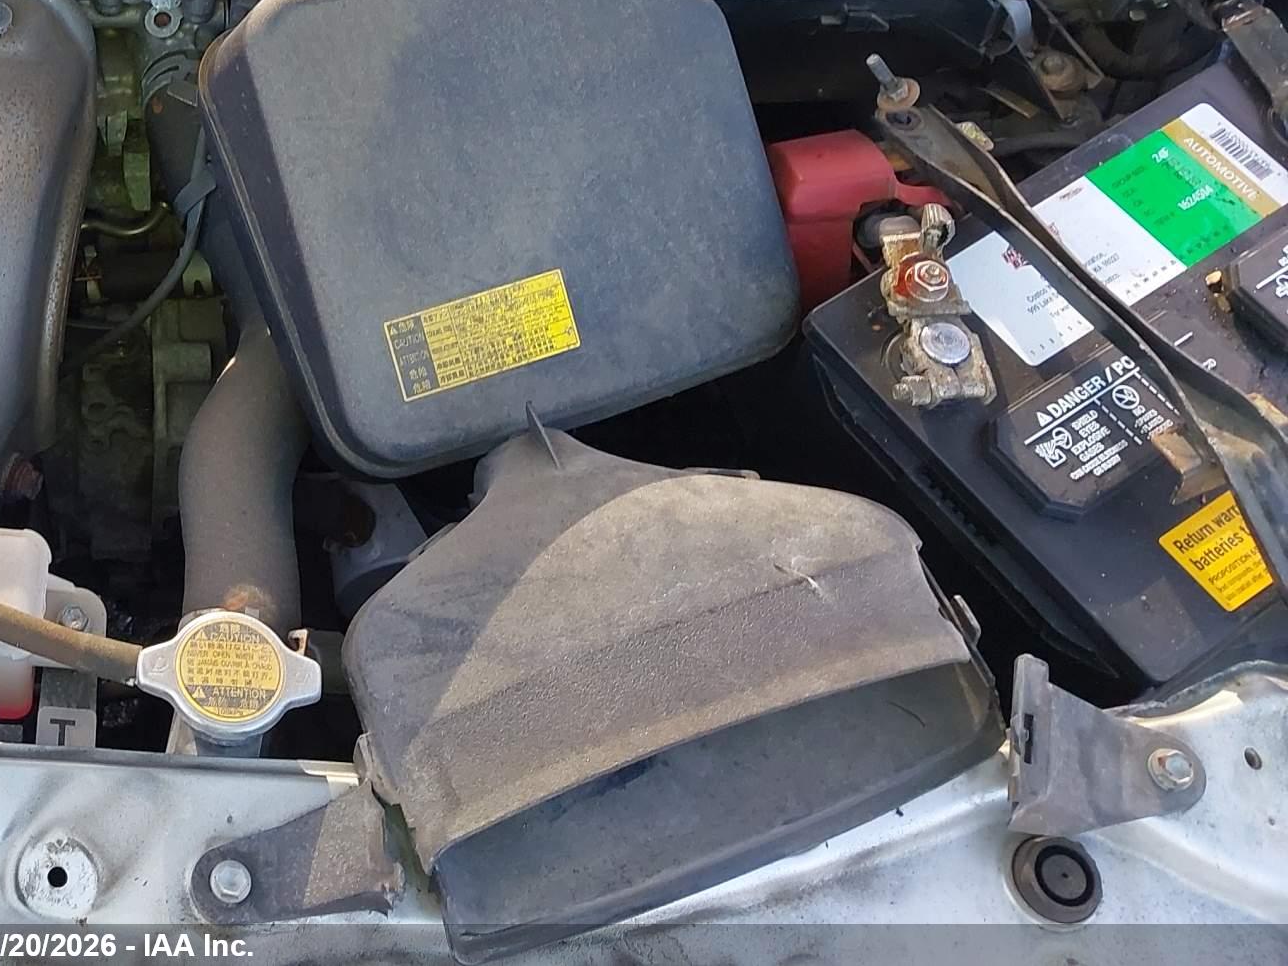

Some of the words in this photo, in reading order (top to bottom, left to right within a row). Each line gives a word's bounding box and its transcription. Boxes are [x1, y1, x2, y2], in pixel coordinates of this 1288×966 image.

[1183, 136, 1259, 201] AUTOMOTIVE
[394, 332, 425, 350] CAUTION
[1046, 375, 1106, 418] DANGER
[1071, 410, 1099, 430] SHIELD
[1078, 421, 1101, 438] EYES
[1079, 442, 1105, 462] GASES
[1173, 523, 1216, 554] Return
[1189, 532, 1244, 571] batteries
[210, 633, 261, 643] CAUTION
[212, 687, 266, 700] ATTENTION
